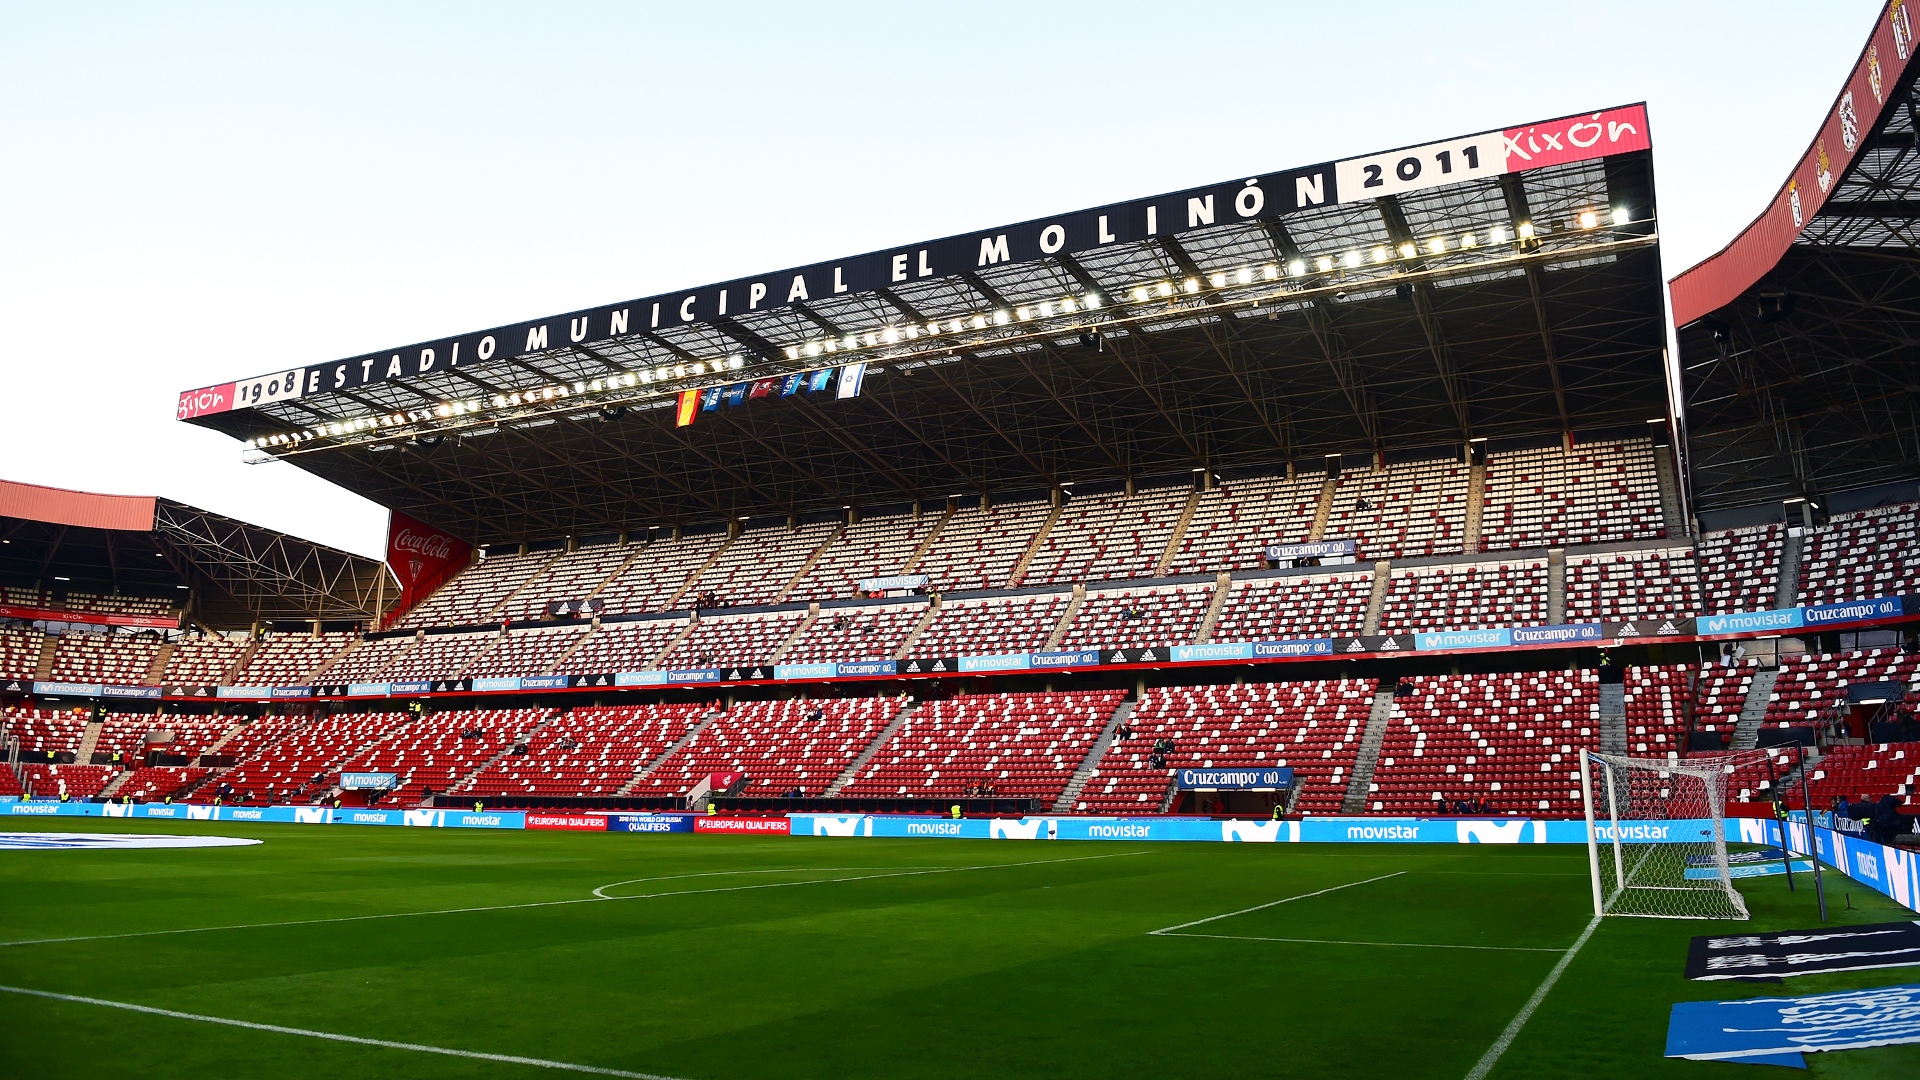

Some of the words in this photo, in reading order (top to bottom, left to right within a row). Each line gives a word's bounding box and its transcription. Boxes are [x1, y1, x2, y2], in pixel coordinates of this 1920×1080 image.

[1363, 145, 1479, 188] 2011
[308, 336, 496, 393] ESTADIO
[525, 266, 848, 352] MUNICIPAL
[892, 249, 933, 283] EL
[977, 173, 1324, 267] MOLINÓN
[242, 372, 295, 404] 1908
[782, 373, 798, 396] UEFA
[708, 387, 722, 407] FIFA
[1270, 543, 1327, 557] Cruzcampo
[1806, 604, 1876, 622] Cruzcampo
[1729, 612, 1792, 628] movistar
[1444, 632, 1501, 646] movistar
[1513, 628, 1578, 642] Cruzcampo
[1195, 645, 1244, 657] movistar
[1255, 642, 1312, 655] Cruzcampo
[979, 656, 1022, 668] movistar
[1032, 653, 1081, 666] Cruzcampo
[793, 666, 830, 675] movistar
[838, 664, 881, 675] Cruzcampo
[629, 673, 662, 682] movistar
[668, 671, 705, 681] Cruzcampo
[54, 684, 95, 693] movistar
[486, 680, 516, 688] movistar
[104, 686, 145, 697] Cruzcampo
[1184, 769, 1257, 787] Cruzcampo
[12, 804, 59, 814] movistar
[148, 807, 175, 817] movistar
[233, 809, 262, 819] movistar
[354, 812, 387, 823] movistar
[463, 814, 501, 826] movistar
[535, 817, 567, 827] EUROPEAN
[568, 817, 604, 828] QUALIFIERS
[629, 822, 670, 832] QUALIFIERS
[706, 819, 743, 829] EUROPEAN
[745, 819, 787, 831] QUALIFIERS
[908, 821, 962, 835] movistar
[1088, 825, 1151, 838] movistar
[1347, 825, 1419, 840] movistar
